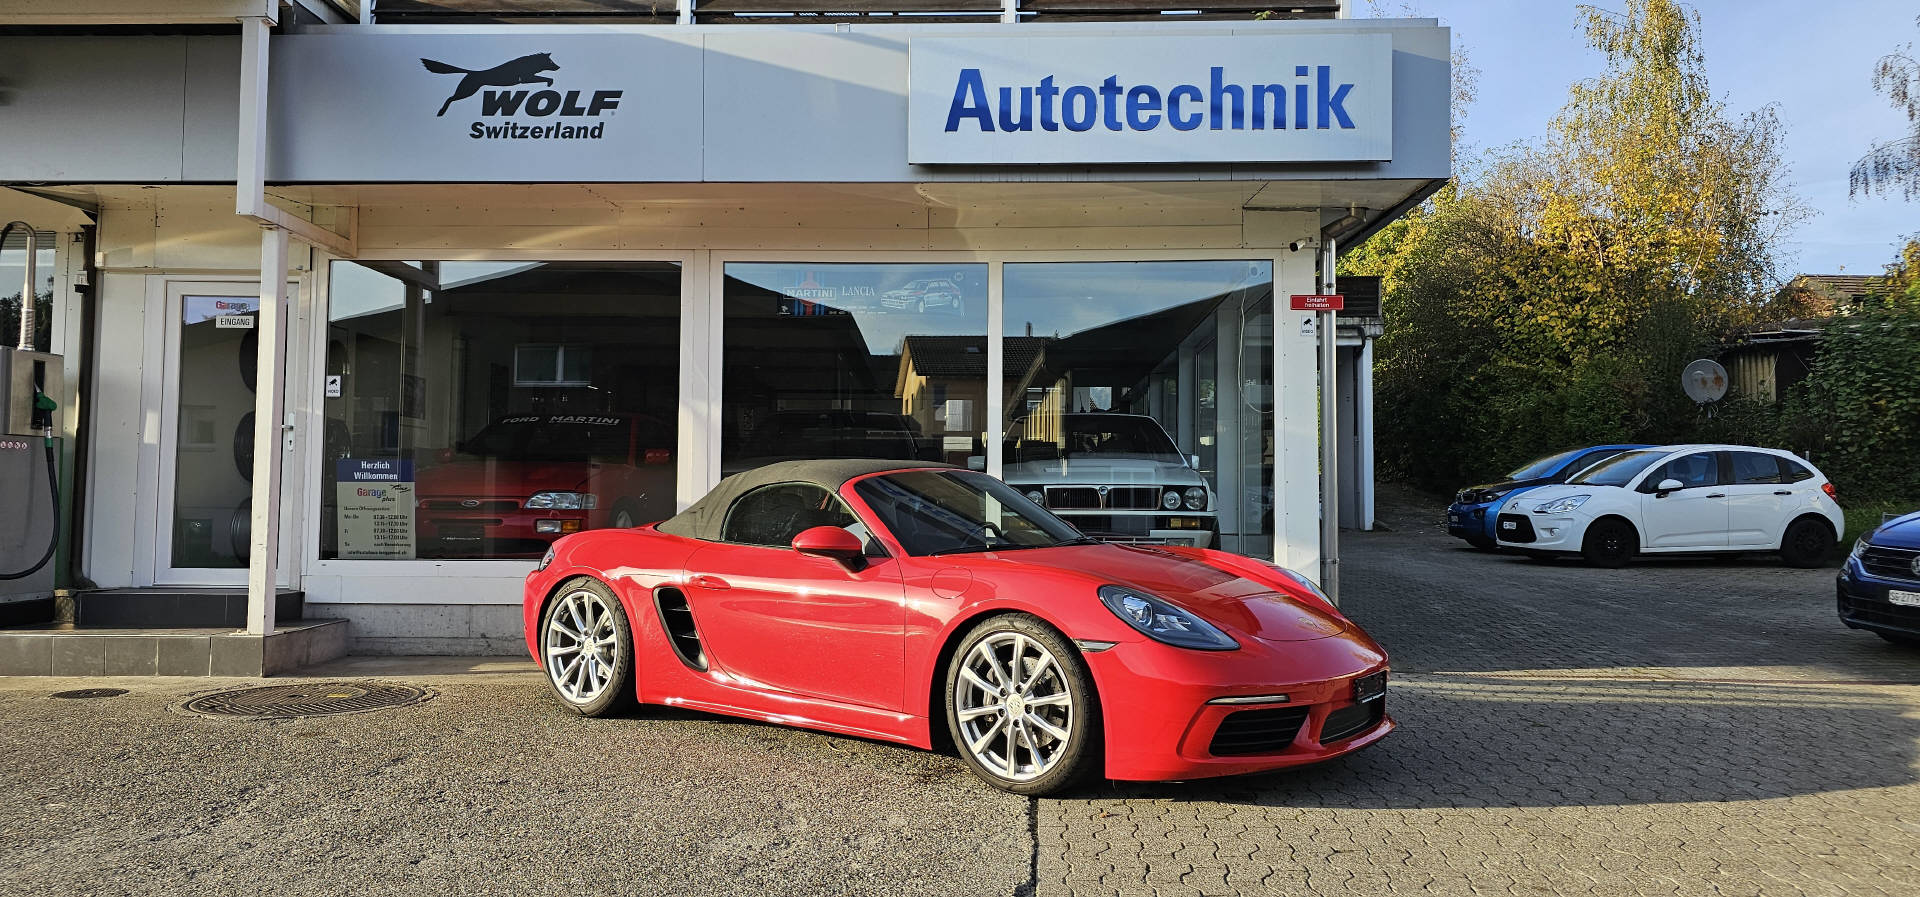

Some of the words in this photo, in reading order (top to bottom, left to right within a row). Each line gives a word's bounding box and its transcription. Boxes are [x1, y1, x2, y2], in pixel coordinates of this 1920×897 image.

[481, 90, 624, 117] WOLF
[944, 65, 1356, 133] Autotechnik
[469, 122, 604, 139] Switzerland
[786, 288, 833, 298] MARTINI
[842, 286, 875, 297] LANCIA
[220, 318, 250, 326] EINGANG
[502, 416, 540, 424] FORD
[549, 415, 621, 425] MARTINI
[361, 461, 390, 469] Herzlich
[354, 472, 398, 480] Willkommen
[357, 487, 387, 498] Garage
